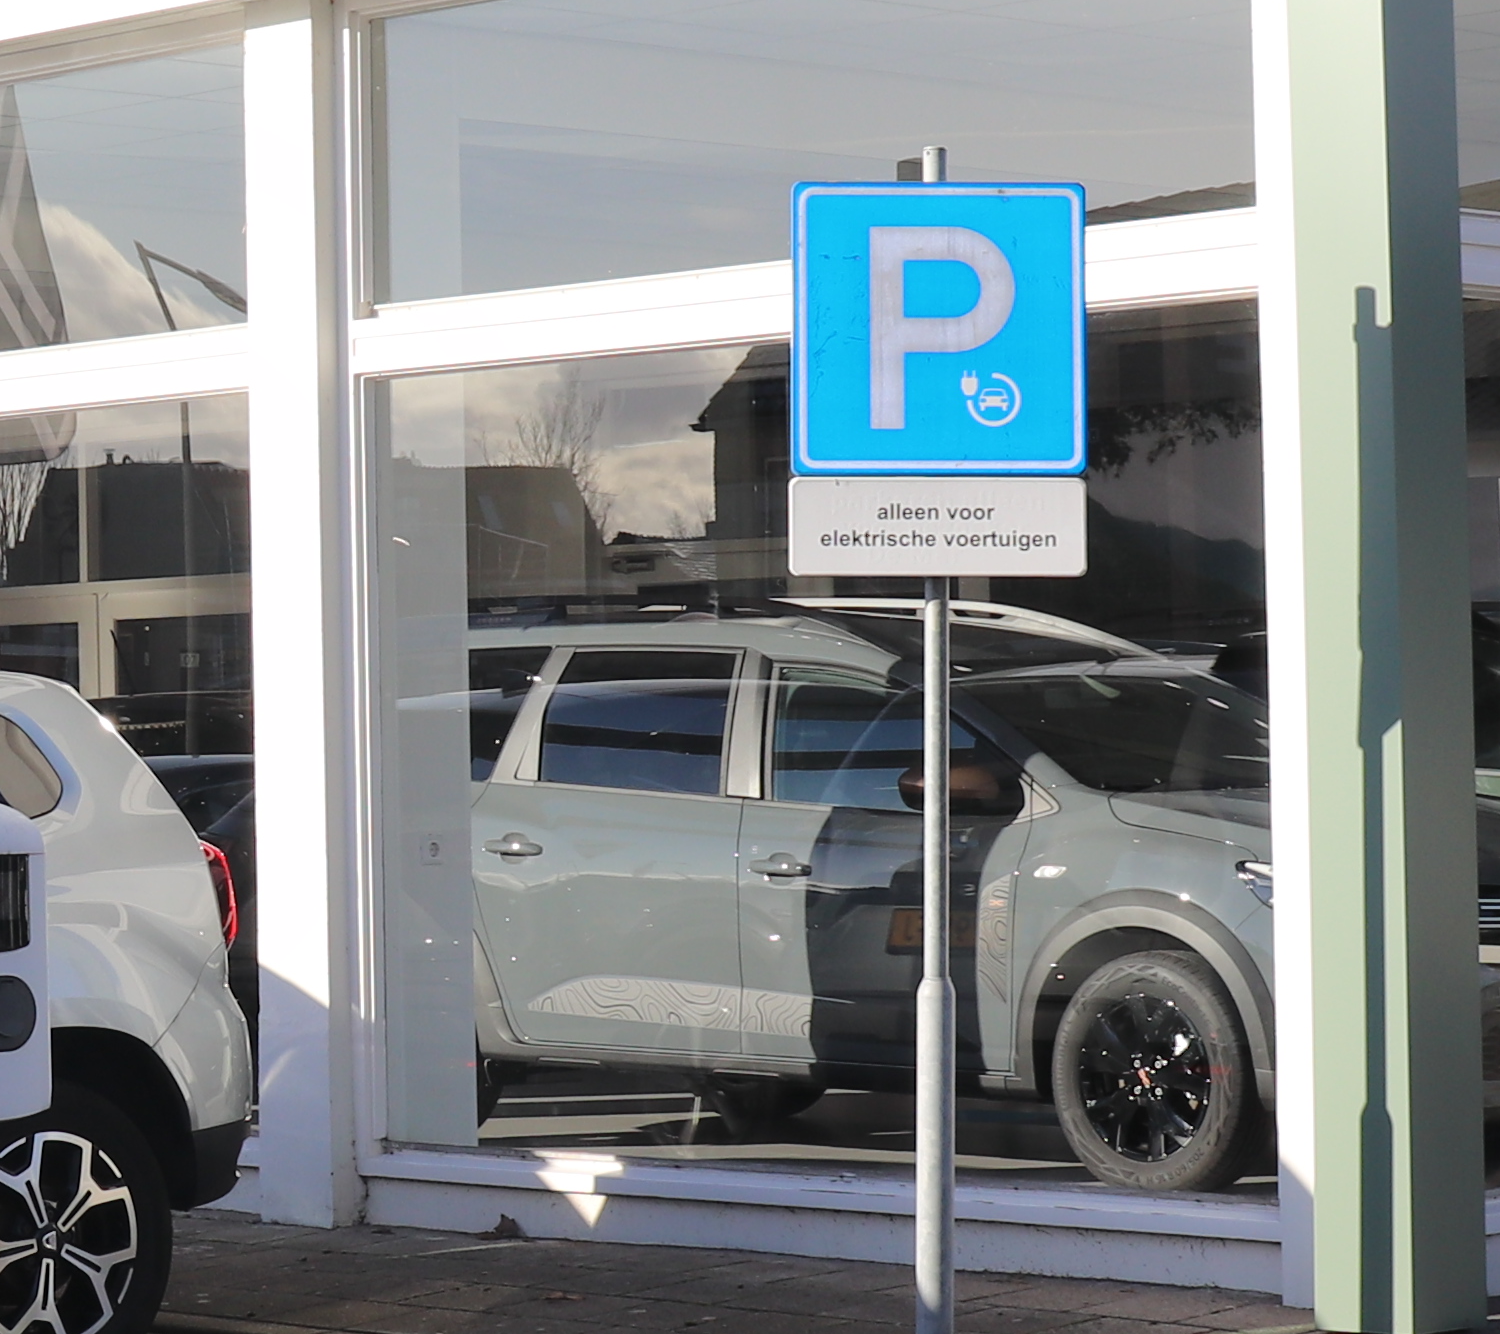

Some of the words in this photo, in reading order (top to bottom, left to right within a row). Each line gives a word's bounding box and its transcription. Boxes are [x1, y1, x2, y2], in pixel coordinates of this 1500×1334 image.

[869, 226, 1015, 429] P
[876, 503, 940, 520] alleen
[946, 506, 996, 520] voor
[820, 529, 937, 547] elektrische
[944, 529, 1057, 551] voertuigen
